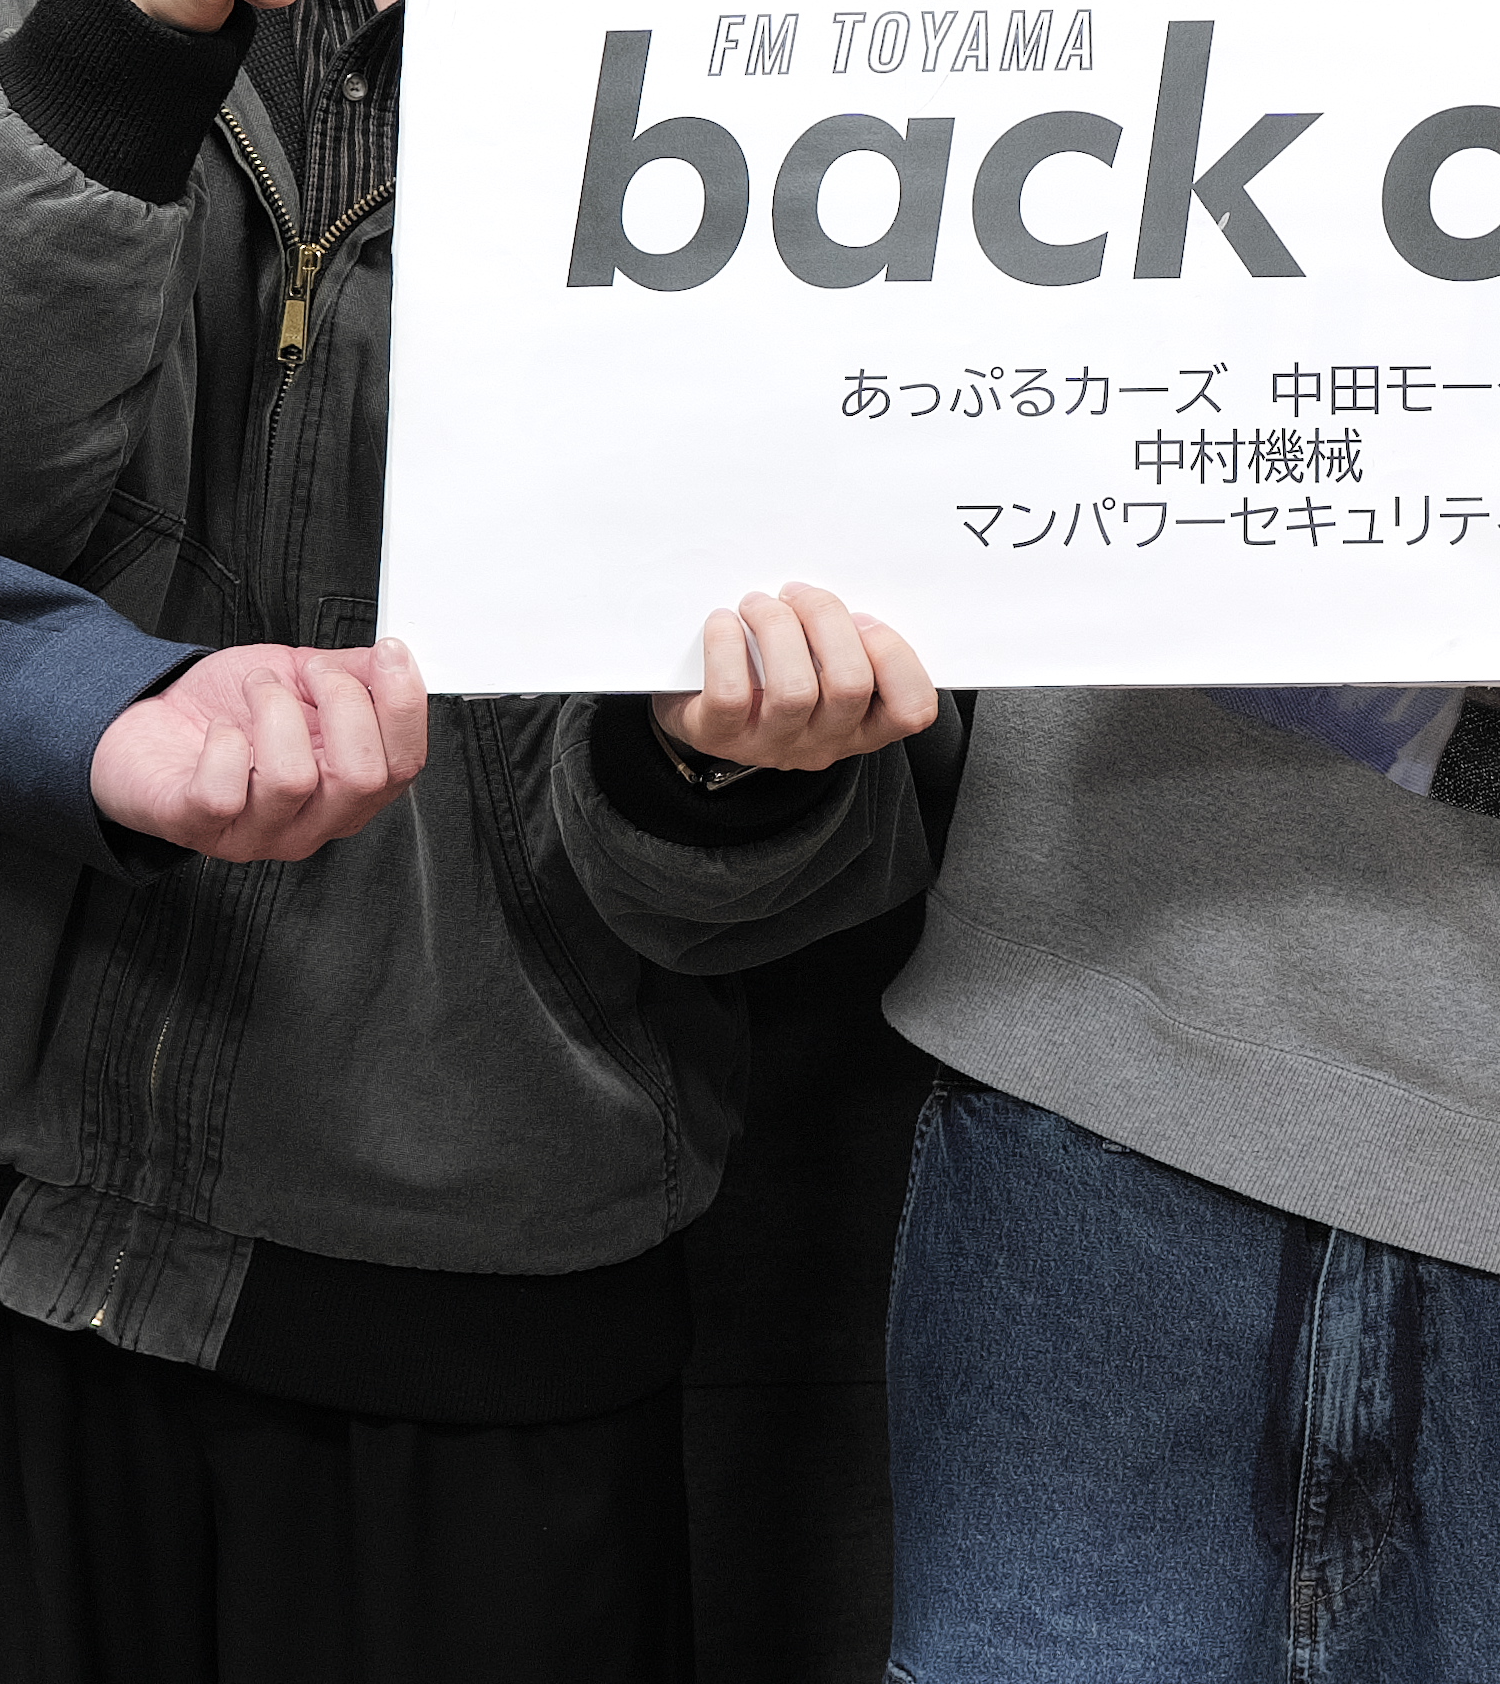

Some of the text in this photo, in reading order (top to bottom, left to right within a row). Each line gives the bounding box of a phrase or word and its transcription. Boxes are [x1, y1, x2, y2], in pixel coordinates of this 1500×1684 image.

[708, 9, 1093, 76] FM TOYAMA
[566, 20, 1325, 292] back
[841, 364, 1229, 420] あっぷるカーズ
[1134, 427, 1364, 485] 中村機械
